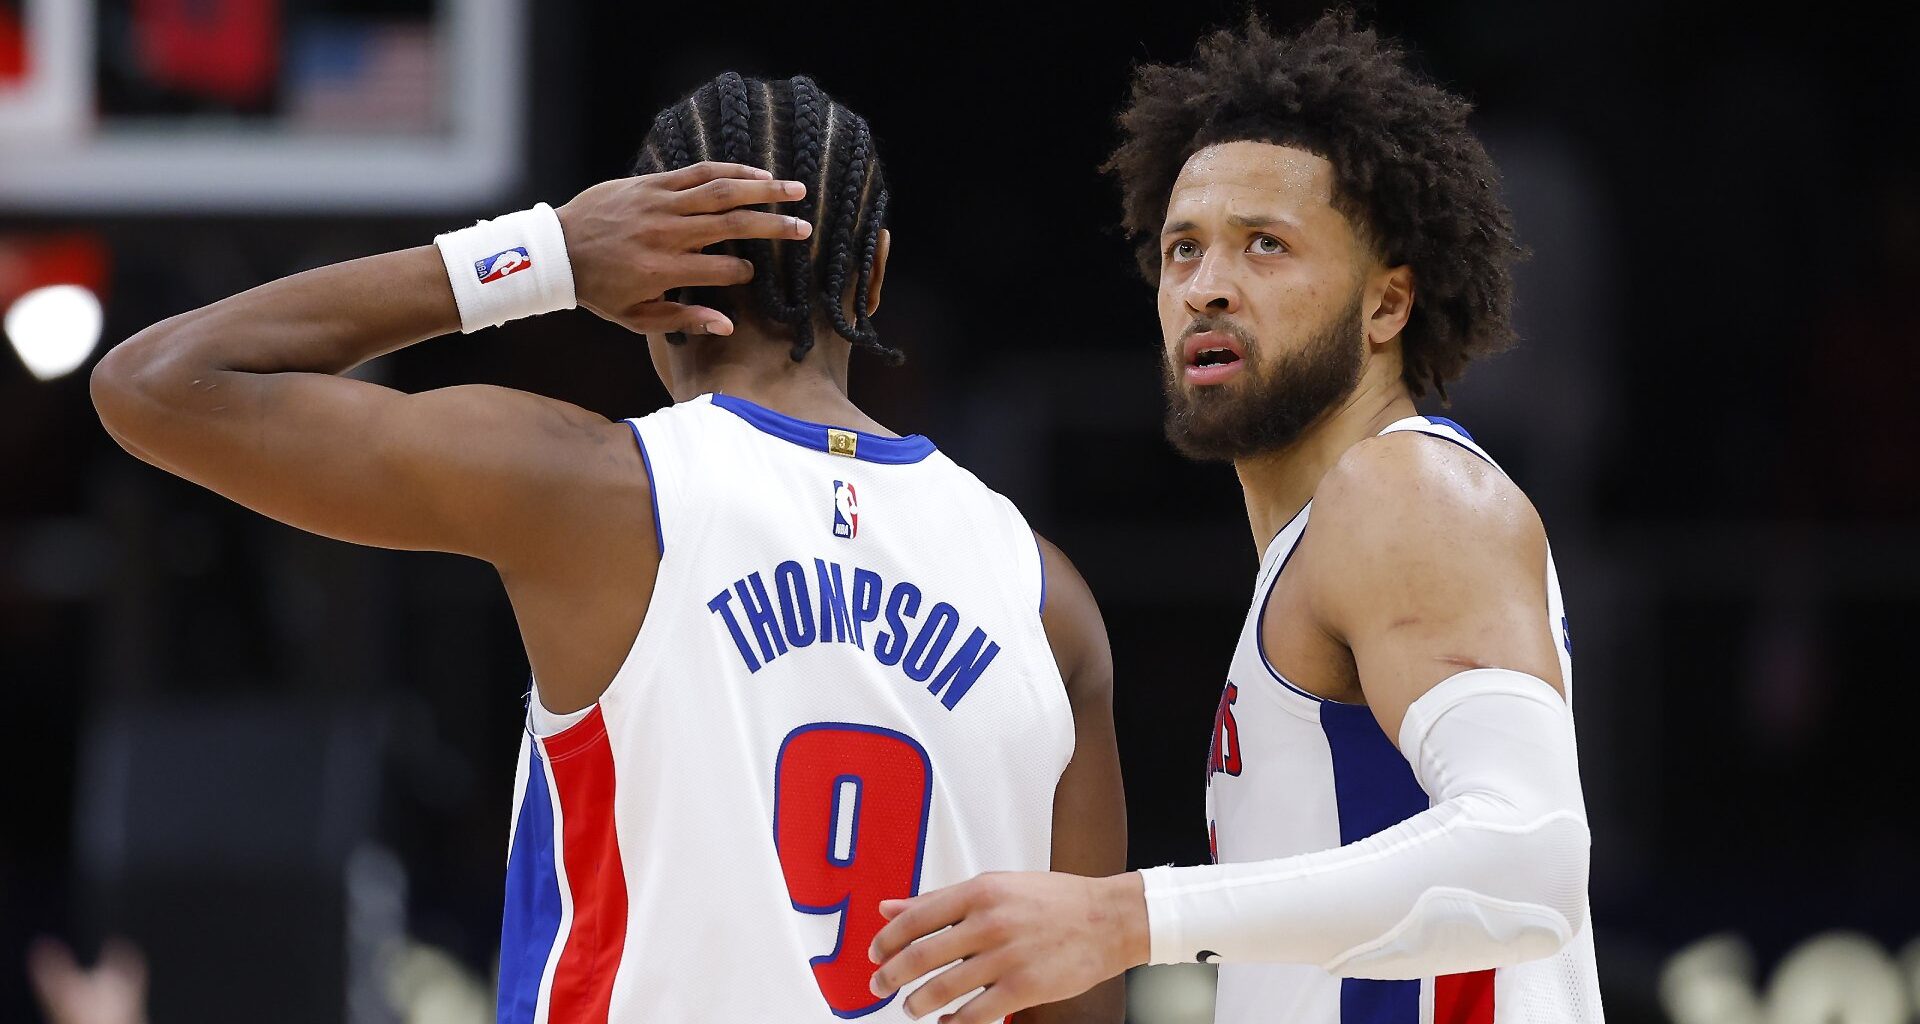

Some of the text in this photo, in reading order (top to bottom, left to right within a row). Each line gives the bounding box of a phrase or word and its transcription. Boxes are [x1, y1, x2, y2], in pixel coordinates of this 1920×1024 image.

[476, 260, 488, 277] NBA
[835, 523, 849, 536] NBA
[707, 557, 1001, 711] THOMPSON
[773, 721, 933, 1020] 9
